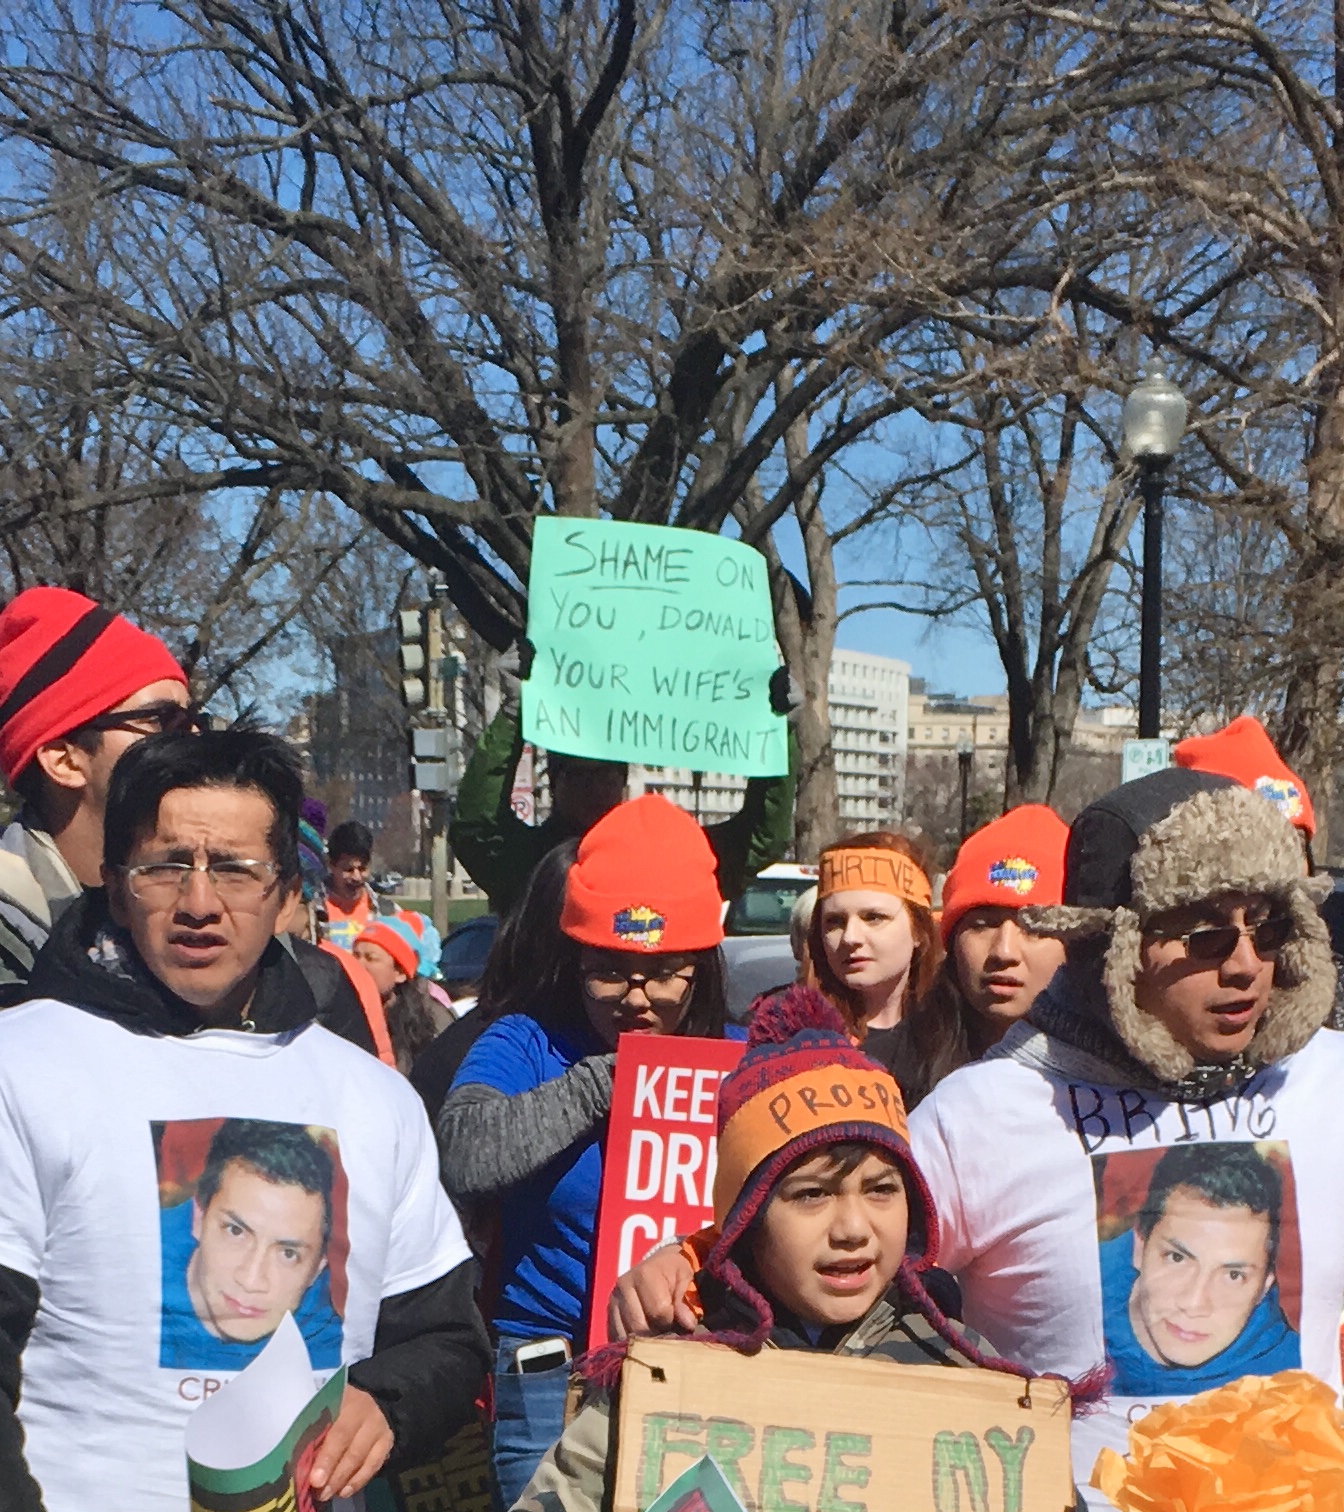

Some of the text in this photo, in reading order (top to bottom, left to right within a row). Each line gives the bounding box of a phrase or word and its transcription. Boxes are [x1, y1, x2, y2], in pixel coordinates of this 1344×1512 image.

[554, 531, 754, 592] SHAME ON
[658, 605, 770, 642] DONALD
[550, 648, 753, 707] YOUR WIFE'S
[535, 699, 778, 766] AN IMMIGRANT
[821, 855, 914, 896] THRIVE
[633, 1065, 729, 1123] KEE
[768, 1082, 907, 1136] PROSPE
